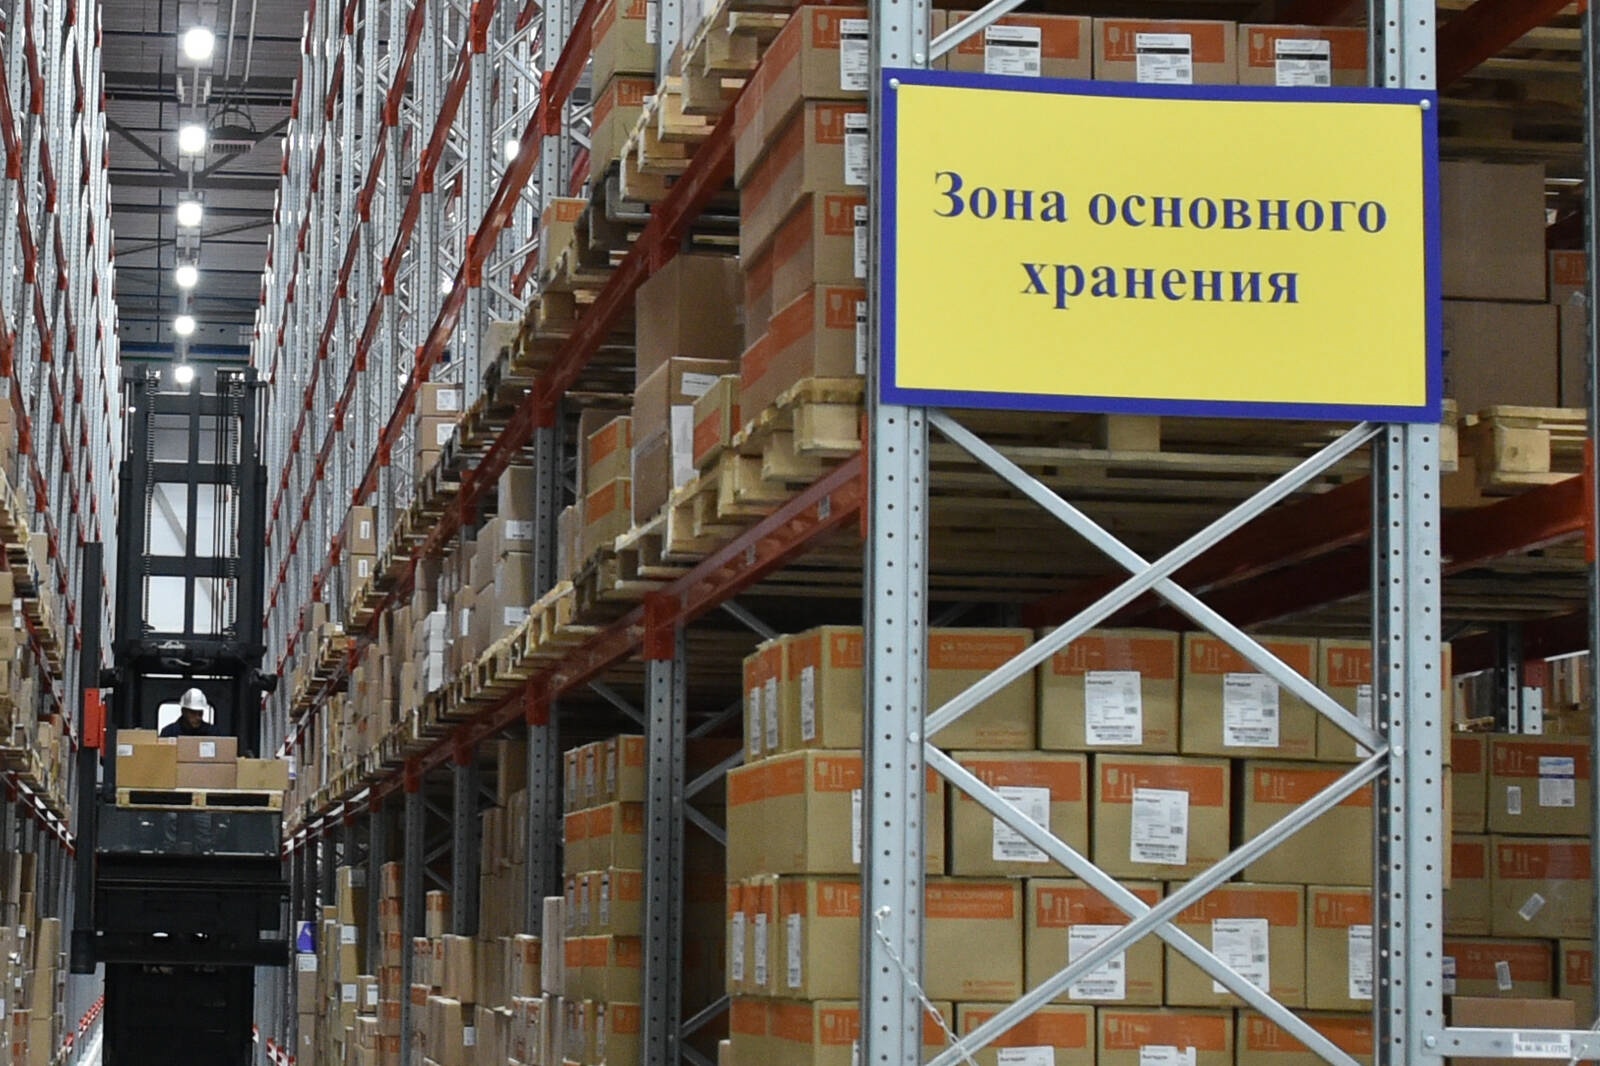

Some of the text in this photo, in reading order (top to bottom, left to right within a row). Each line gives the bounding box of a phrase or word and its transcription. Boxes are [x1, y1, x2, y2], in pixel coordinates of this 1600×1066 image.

[934, 170, 1388, 234] Зона основного
[1021, 262, 1299, 310] хранения
